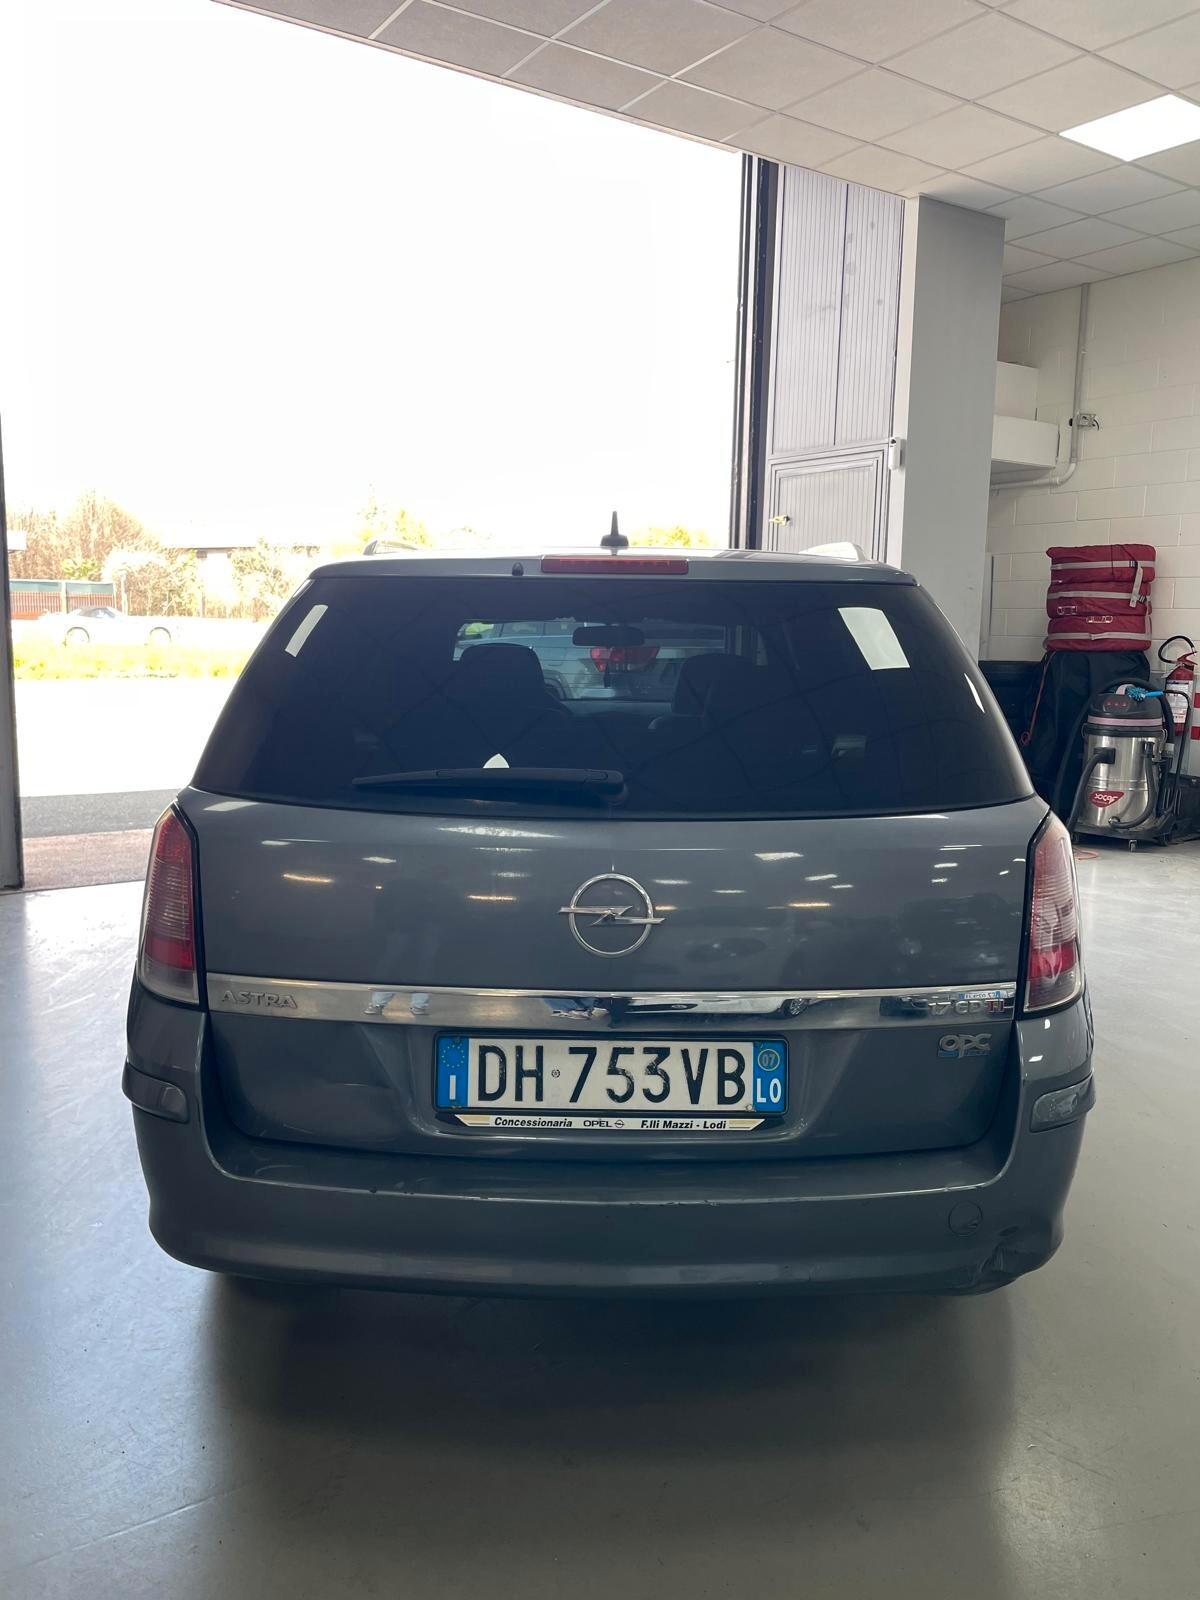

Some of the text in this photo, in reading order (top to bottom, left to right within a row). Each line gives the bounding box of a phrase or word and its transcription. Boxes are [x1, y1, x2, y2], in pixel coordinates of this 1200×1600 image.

[222, 990, 298, 1009] ASTRA
[762, 1053, 776, 1068] 07
[449, 1074, 457, 1101] I
[477, 1044, 544, 1102] DH
[756, 1077, 782, 1104] LO
[494, 1116, 573, 1128] Concessionaria
[583, 1119, 613, 1128] OPEL
[662, 1119, 693, 1129] Mazzi
[702, 1120, 726, 1130] Lodi
